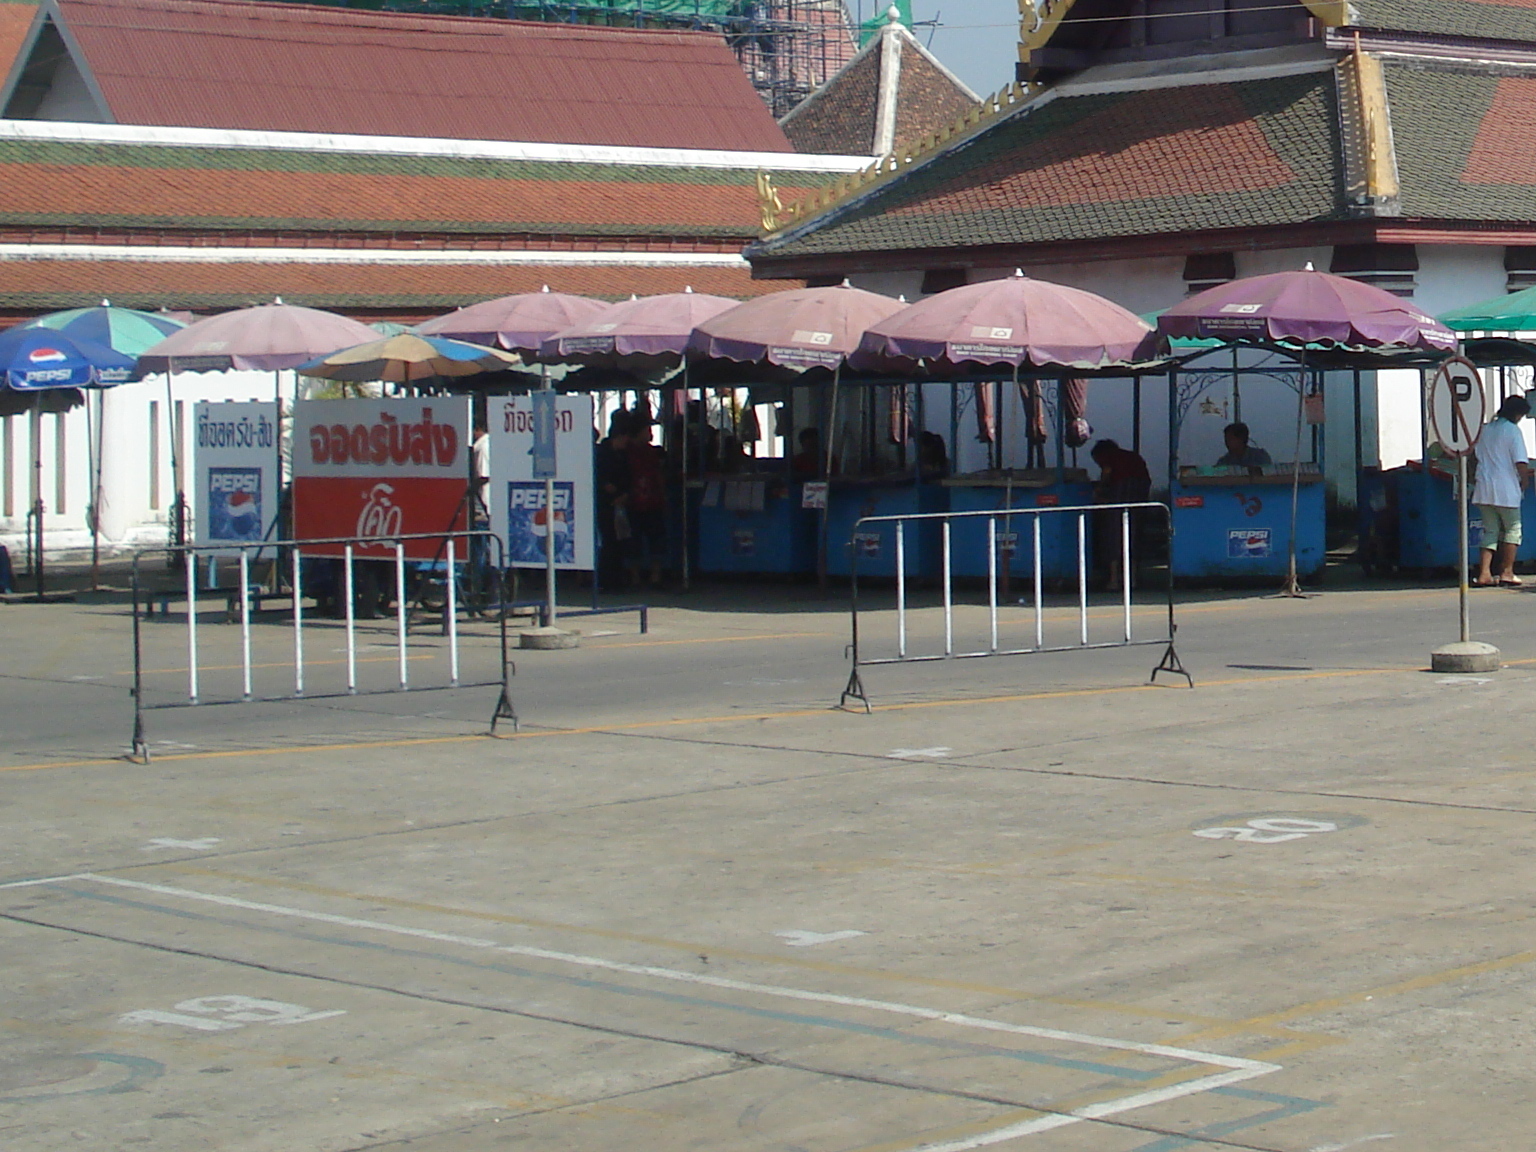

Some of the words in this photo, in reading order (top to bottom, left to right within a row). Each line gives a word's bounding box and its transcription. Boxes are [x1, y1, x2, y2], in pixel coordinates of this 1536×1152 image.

[26, 368, 72, 383] PEPSI
[1450, 376, 1471, 443] P
[310, 406, 458, 466] จอดรับส่ง
[210, 474, 259, 492] PEPSI
[1229, 530, 1269, 539] PEPSI
[1192, 817, 1338, 844] 20
